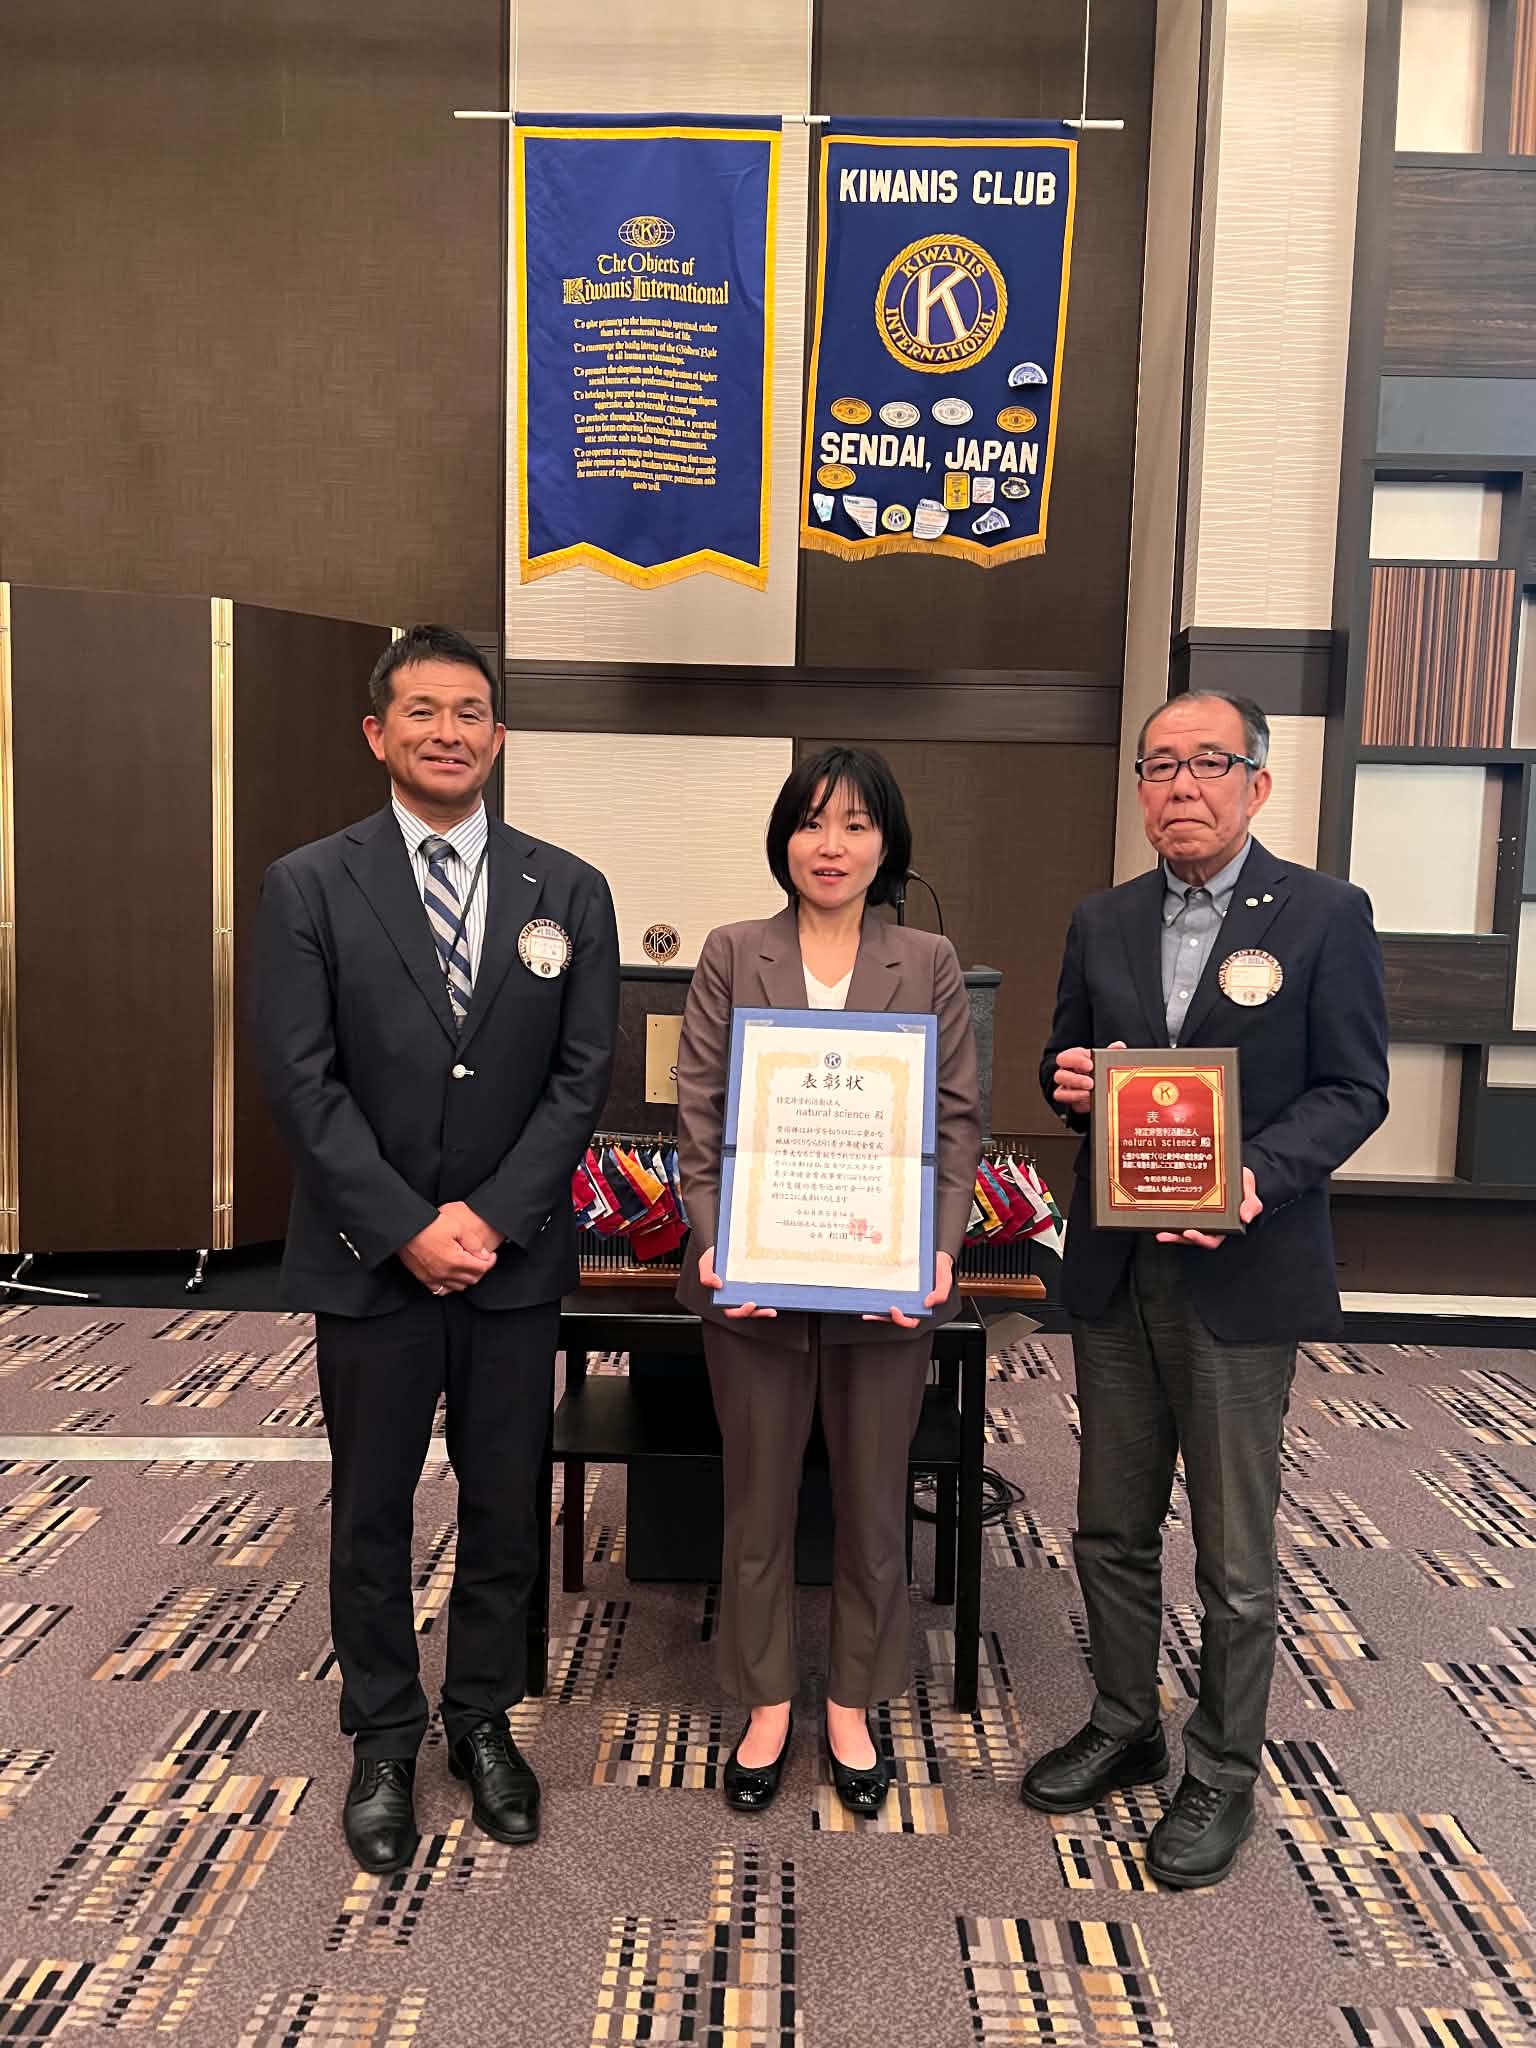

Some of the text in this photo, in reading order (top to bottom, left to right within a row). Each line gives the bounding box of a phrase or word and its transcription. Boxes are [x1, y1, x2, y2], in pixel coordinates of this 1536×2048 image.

[840, 168, 1056, 206] KIWANIS CLUB
[640, 224, 654, 241] K
[597, 252, 695, 276] The Objects of
[900, 245, 985, 279] KIWANIS
[563, 275, 729, 305] Kiwanis International
[916, 265, 970, 346] K
[886, 307, 996, 362] INTERNATIONAL
[820, 432, 1038, 475] SENDAI, JAPAN
[654, 931, 671, 953] K
[801, 1072, 864, 1092] 表彰状
[1159, 1086, 1171, 1100] K
[796, 1108, 831, 1118] natural
[834, 1110, 870, 1120] science
[1122, 1137, 1156, 1147] natural
[1161, 1138, 1196, 1147] science
